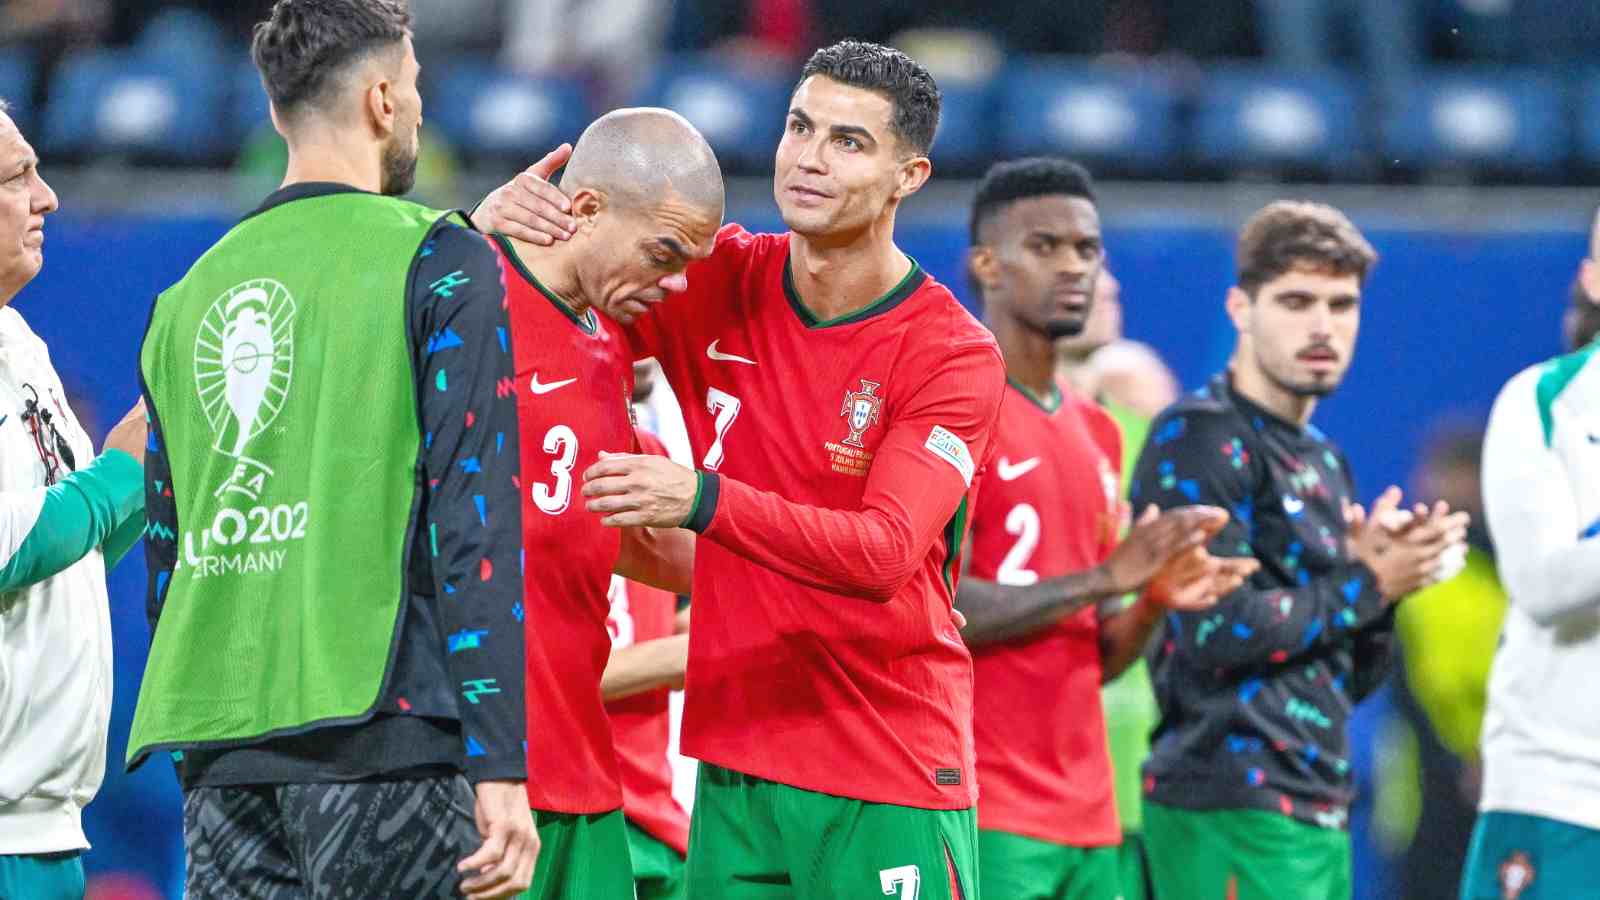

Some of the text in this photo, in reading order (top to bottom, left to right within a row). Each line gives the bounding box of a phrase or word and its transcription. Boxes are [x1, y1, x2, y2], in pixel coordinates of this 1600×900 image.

[532, 425, 577, 515] 3
[703, 386, 741, 471] 7
[996, 503, 1040, 587] 2
[879, 864, 920, 900] 7
